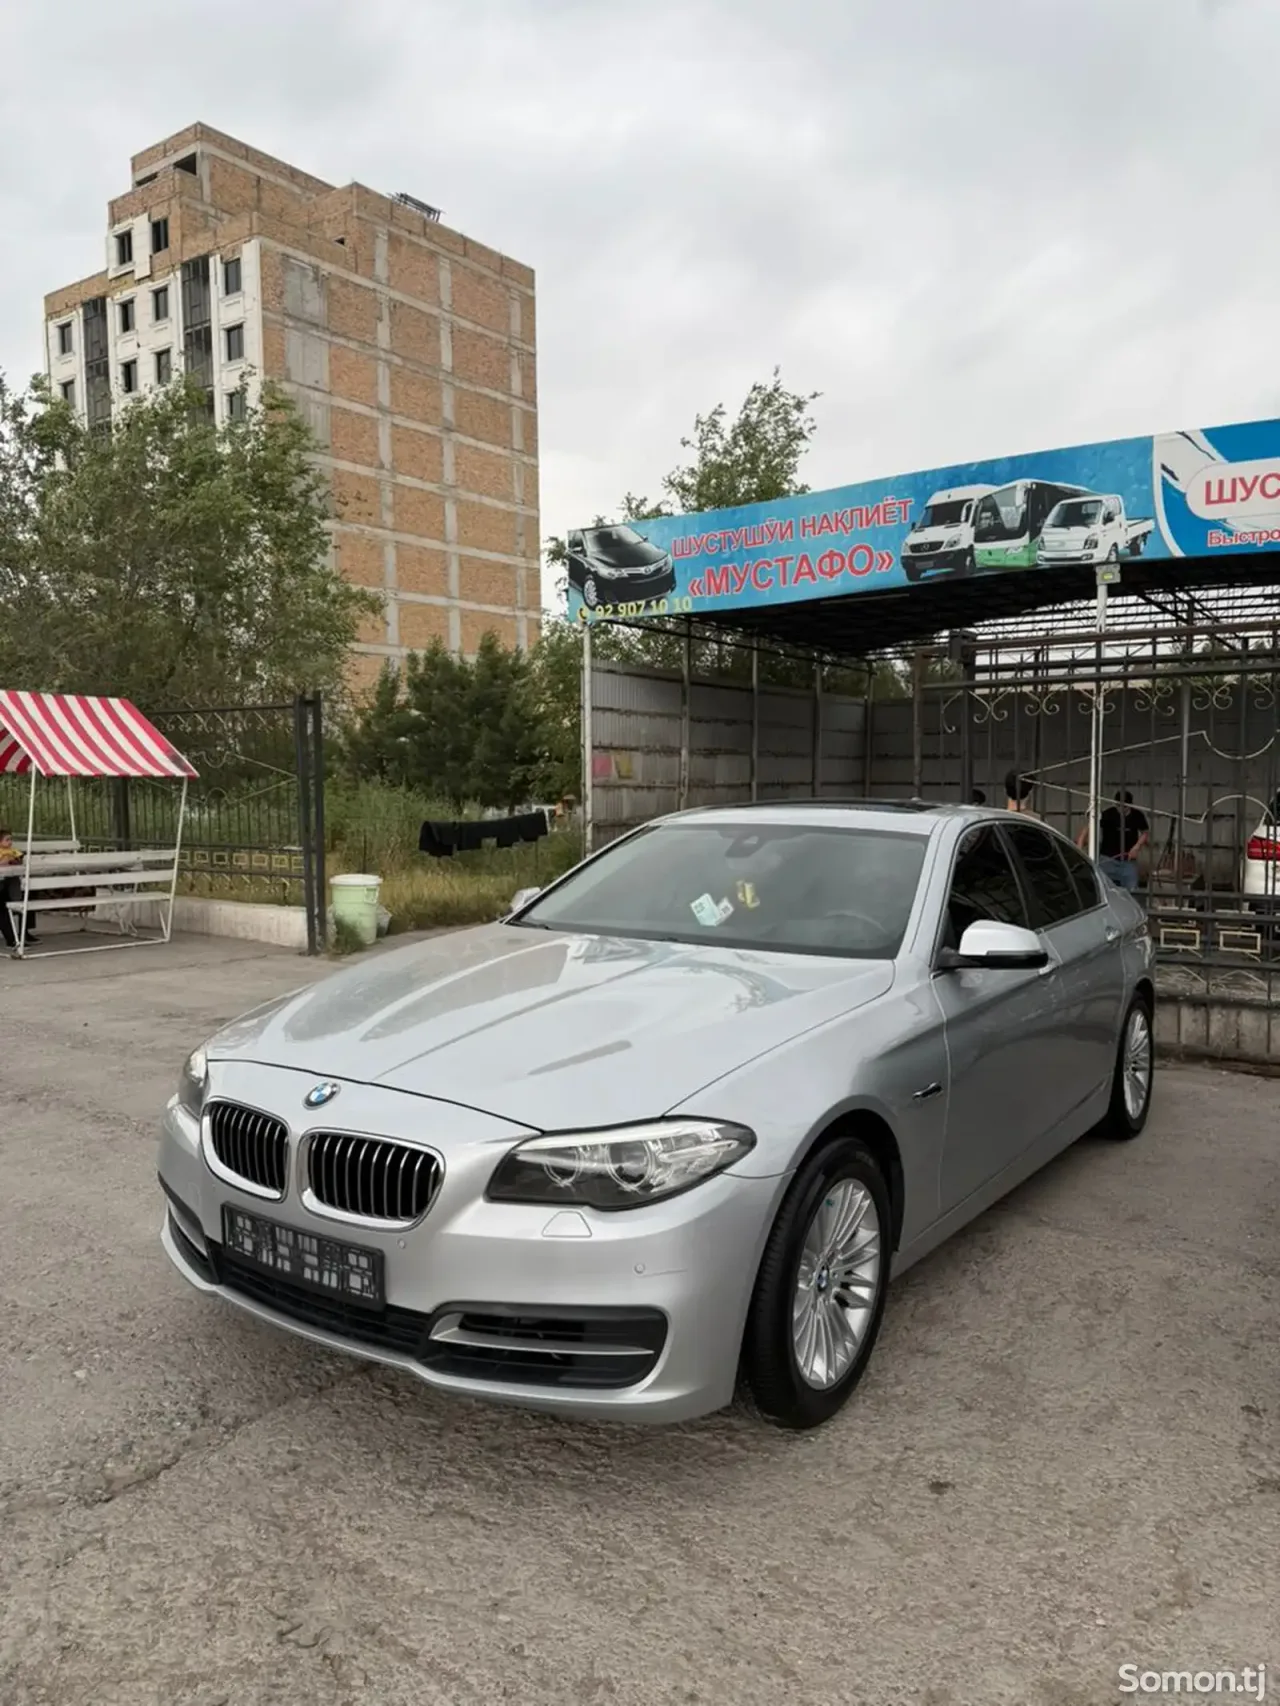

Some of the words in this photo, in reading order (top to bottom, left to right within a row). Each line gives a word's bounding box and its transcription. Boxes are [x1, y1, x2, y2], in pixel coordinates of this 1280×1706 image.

[800, 495, 914, 539] НАҚЛИЁТ
[688, 544, 895, 598] «МУСТАФО»
[595, 604, 613, 618] 92
[617, 600, 646, 617] 907
[650, 598, 669, 614] 10
[673, 596, 693, 612] 10
